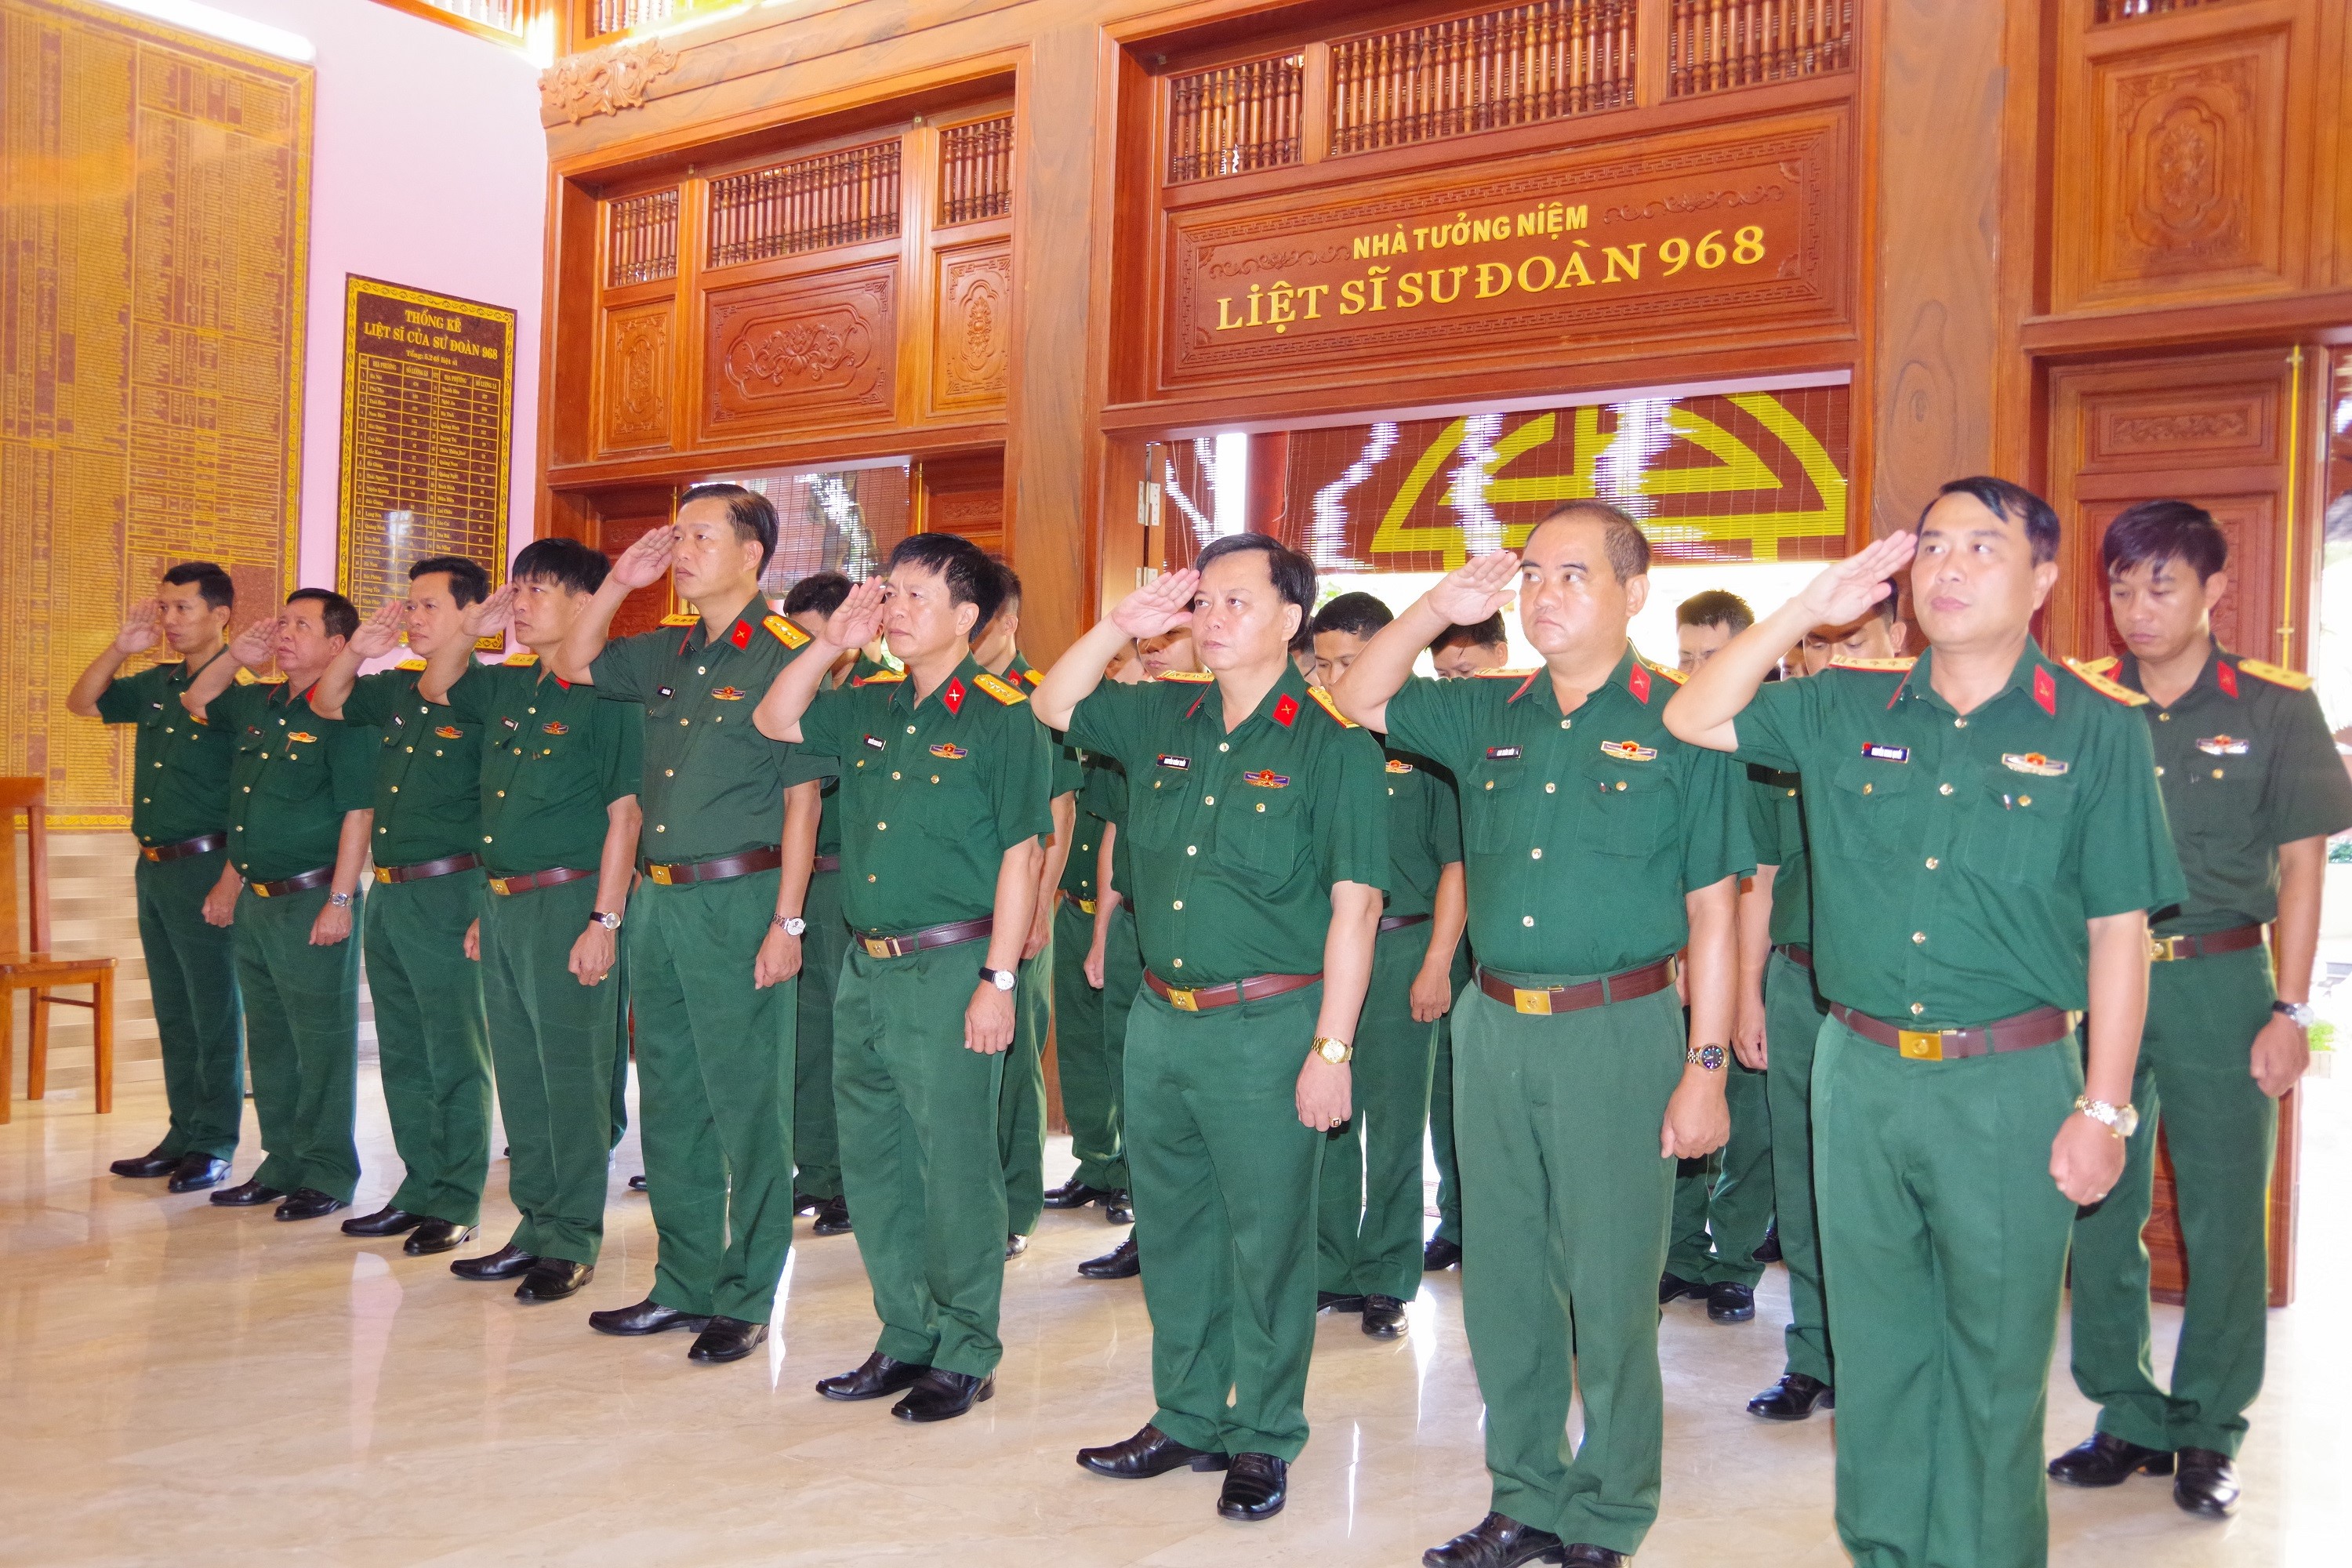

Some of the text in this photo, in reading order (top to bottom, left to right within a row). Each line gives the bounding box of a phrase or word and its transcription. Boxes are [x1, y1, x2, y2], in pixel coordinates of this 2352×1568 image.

[1353, 224, 1408, 260] NHÀ
[1414, 212, 1512, 252] TƯỞNG
[1339, 266, 1392, 316] SĨ
[1396, 265, 1468, 308] SƯ
[1475, 239, 1647, 299] ĐOÀN
[1658, 226, 1766, 277] 968
[364, 321, 498, 360] LIỆT SĨ CỦA SƯ ĐOÀN 968
[405, 309, 462, 333] THỐNG KÊ
